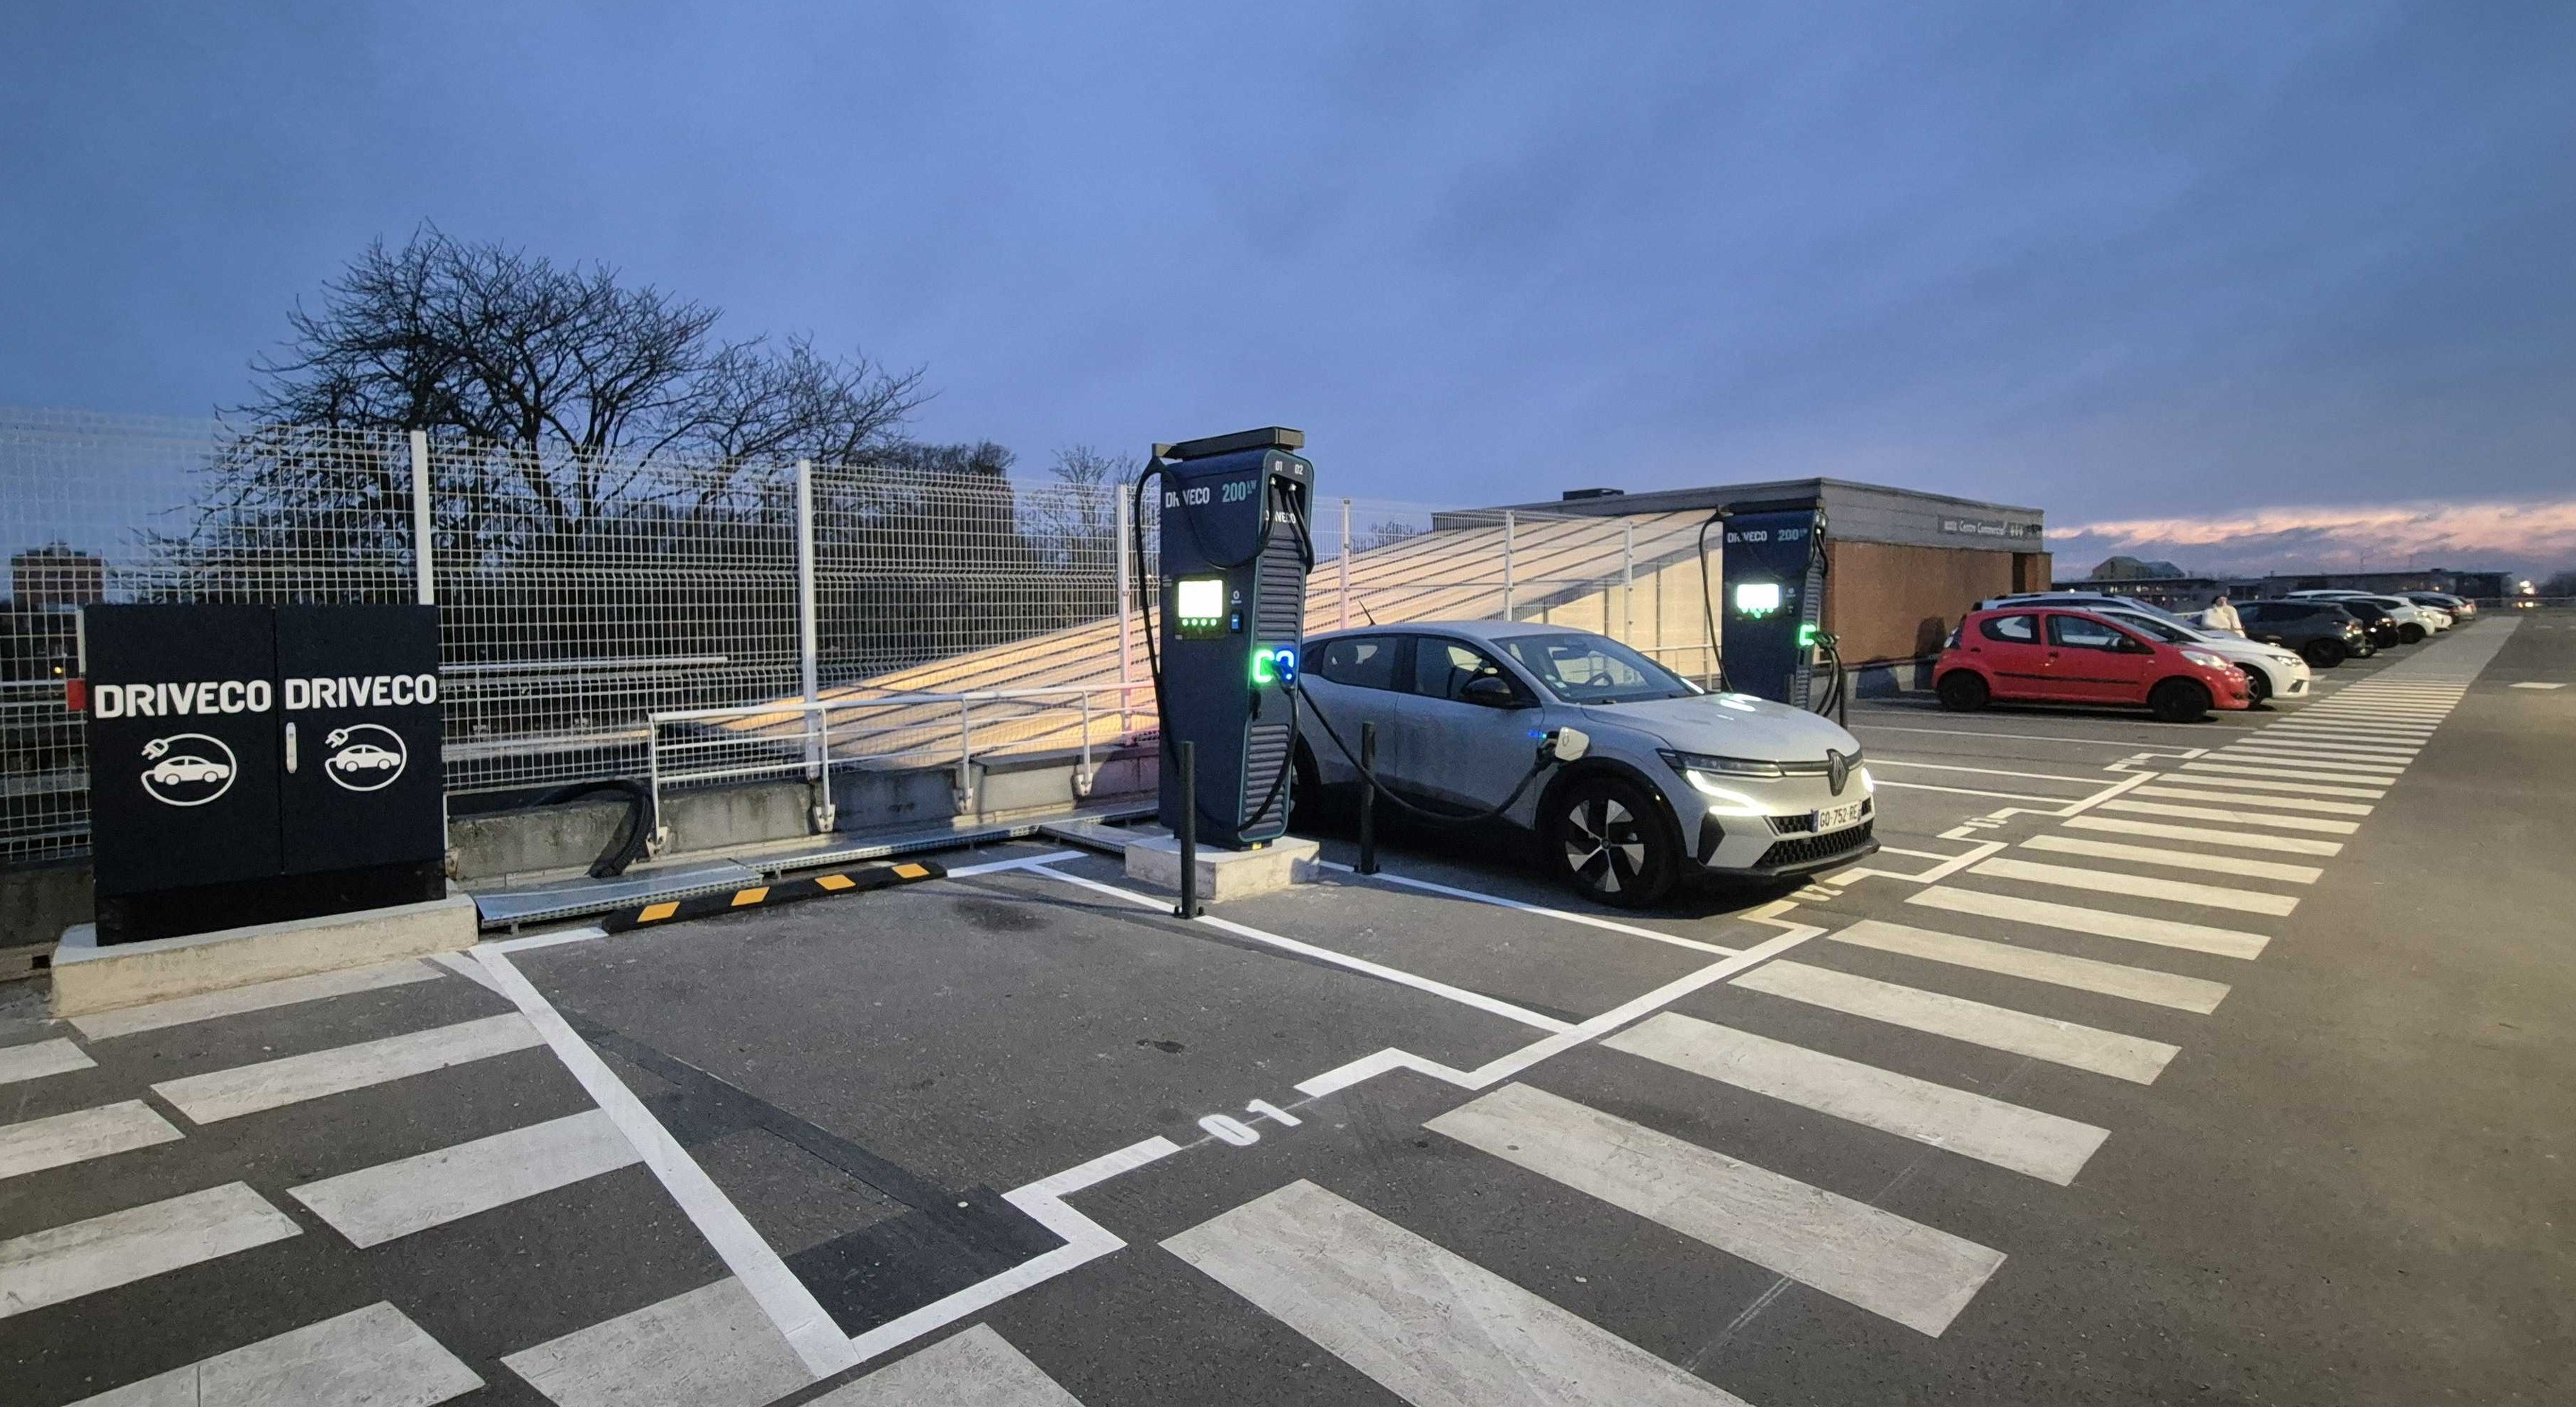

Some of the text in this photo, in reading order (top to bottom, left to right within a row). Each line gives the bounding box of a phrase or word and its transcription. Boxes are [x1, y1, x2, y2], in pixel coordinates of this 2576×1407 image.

[1275, 461, 1303, 475] 01 02
[94, 679, 272, 719] DRIVECO
[284, 673, 437, 710] DRIVECO
[1197, 1098, 1303, 1146] 01
